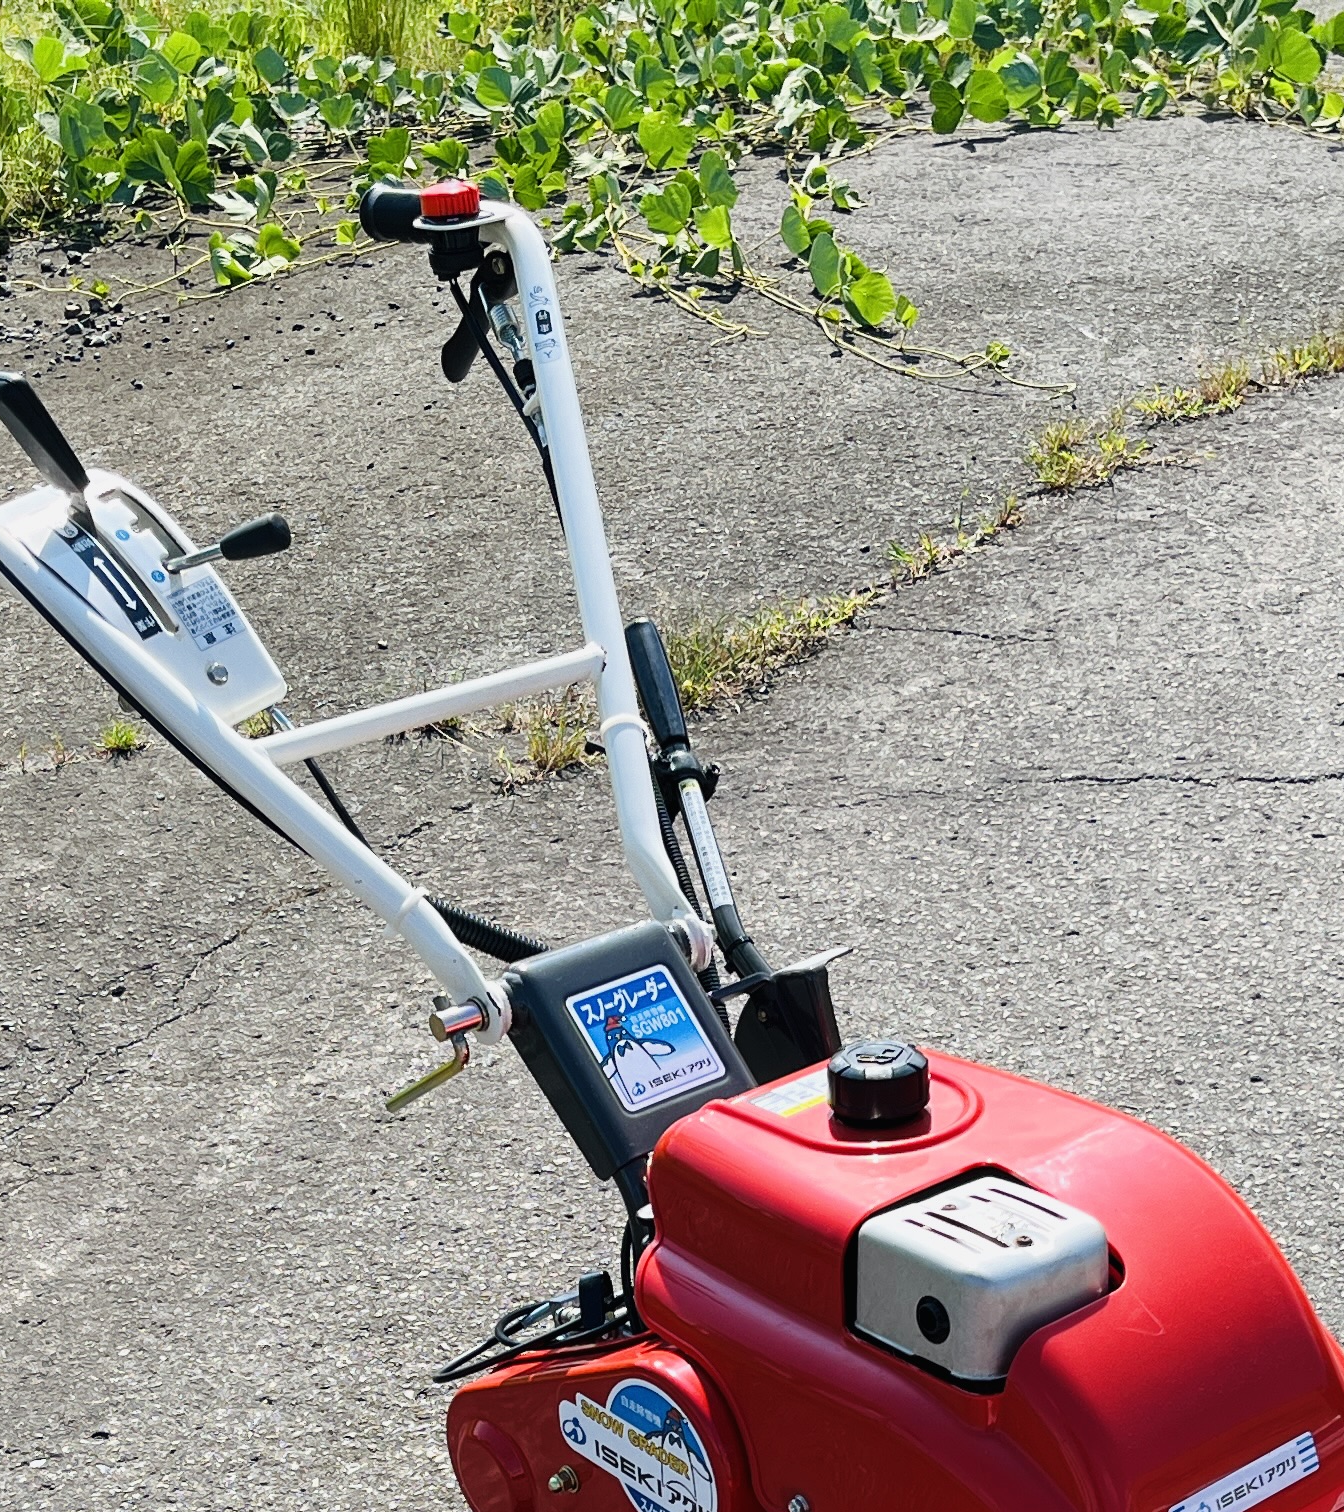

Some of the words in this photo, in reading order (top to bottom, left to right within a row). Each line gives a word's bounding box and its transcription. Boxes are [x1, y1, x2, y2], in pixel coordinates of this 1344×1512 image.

[580, 977, 668, 1026] スノーグレーダー
[631, 1007, 687, 1039] SGW801
[580, 1398, 624, 1438] SNOW
[627, 1426, 691, 1480] GRADER
